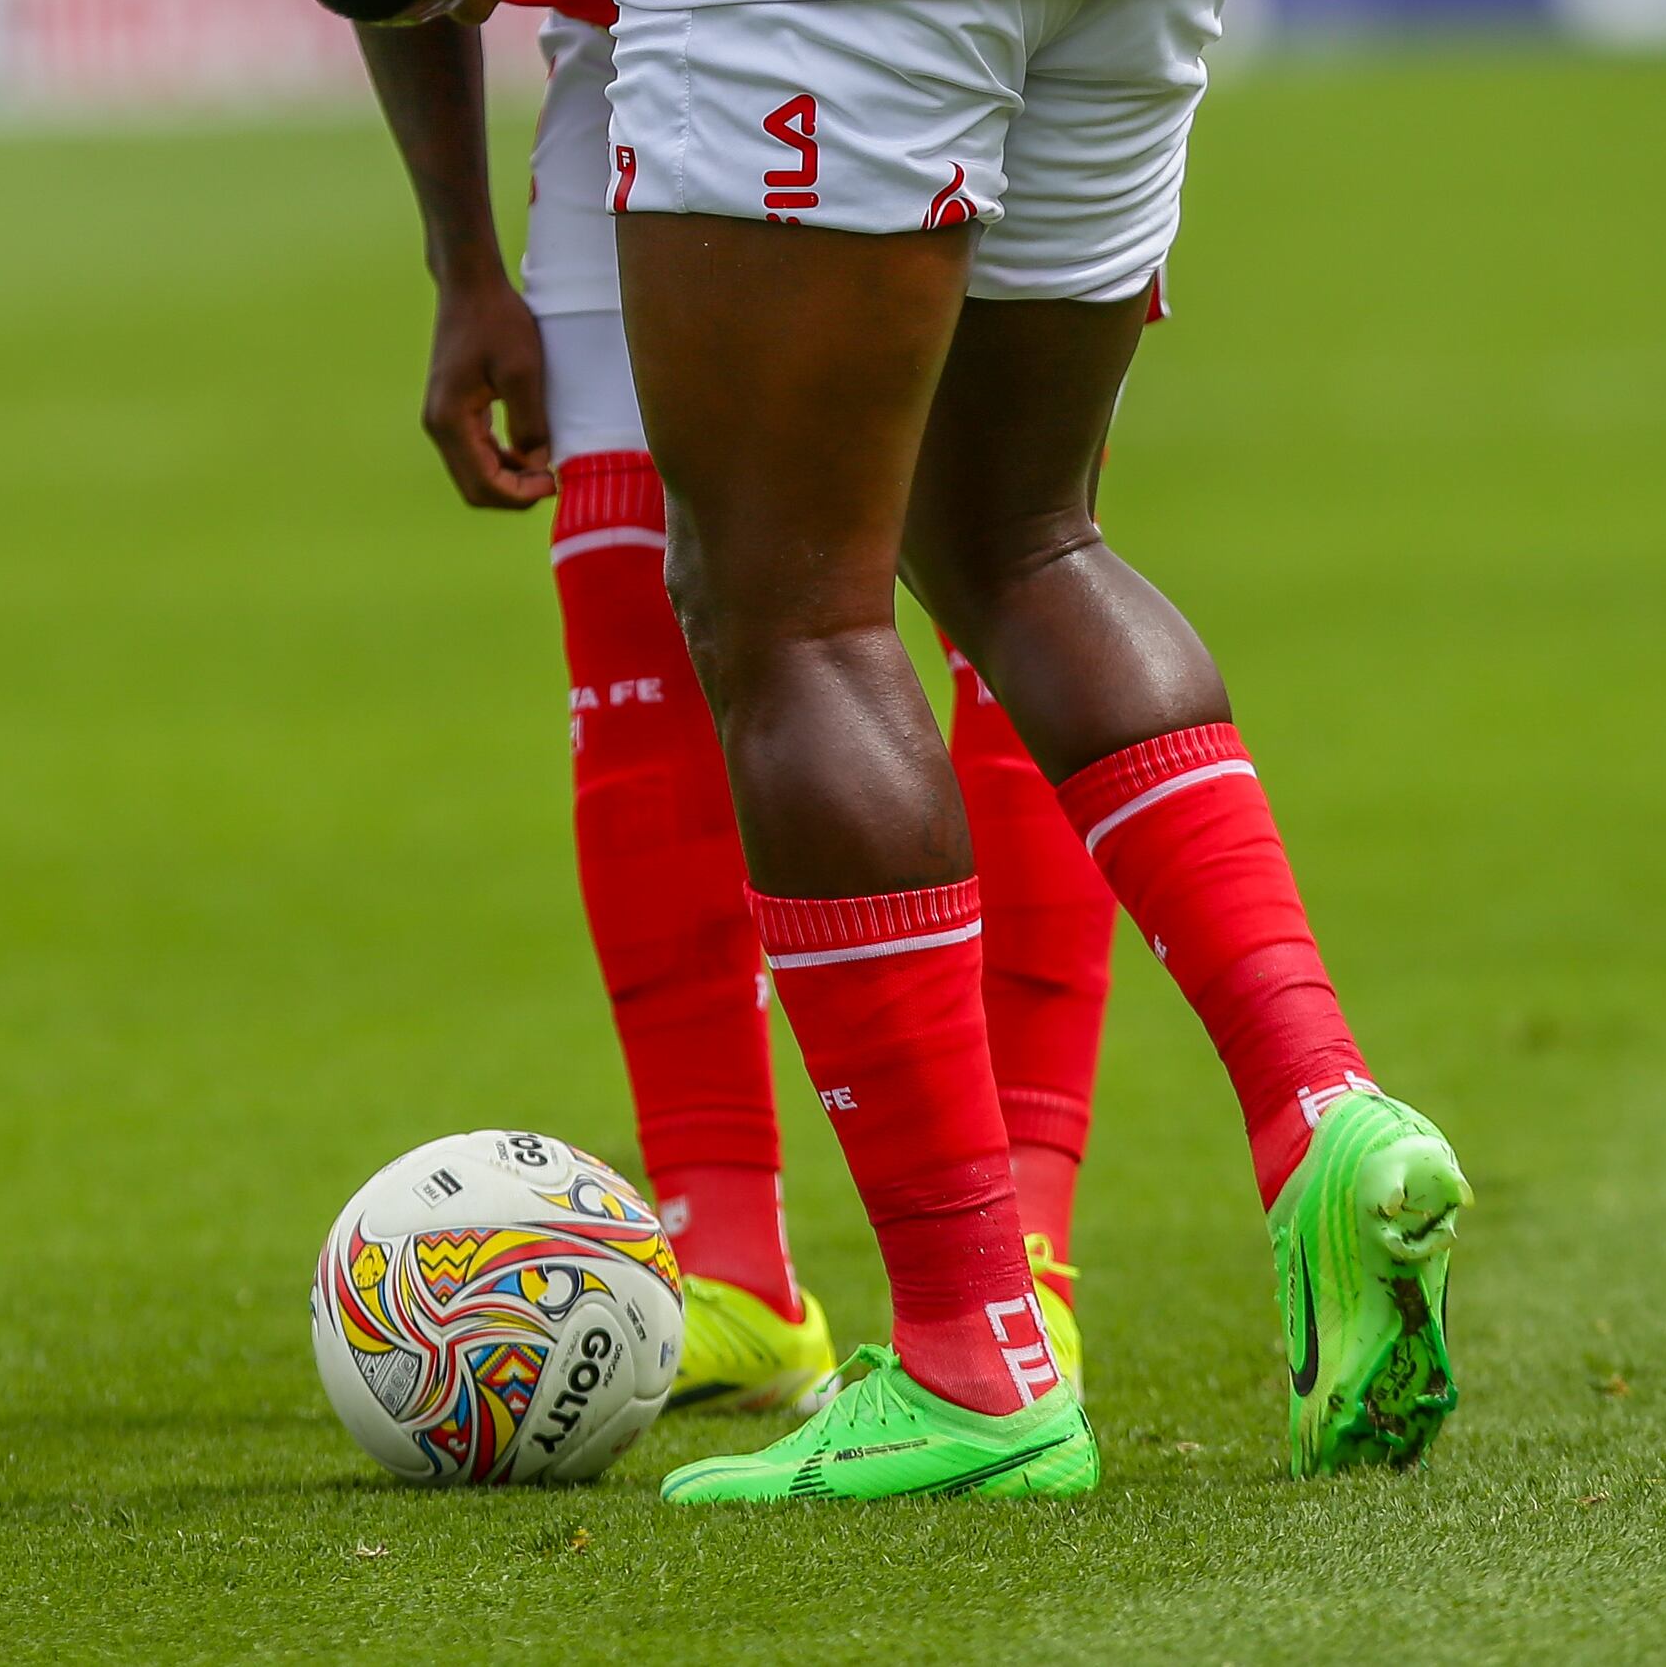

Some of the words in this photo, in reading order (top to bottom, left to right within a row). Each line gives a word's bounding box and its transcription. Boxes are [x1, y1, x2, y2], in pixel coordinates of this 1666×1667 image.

[761, 92, 820, 226] ILA
[820, 1086, 858, 1111] FE
[531, 1326, 613, 1455] GOLTY
